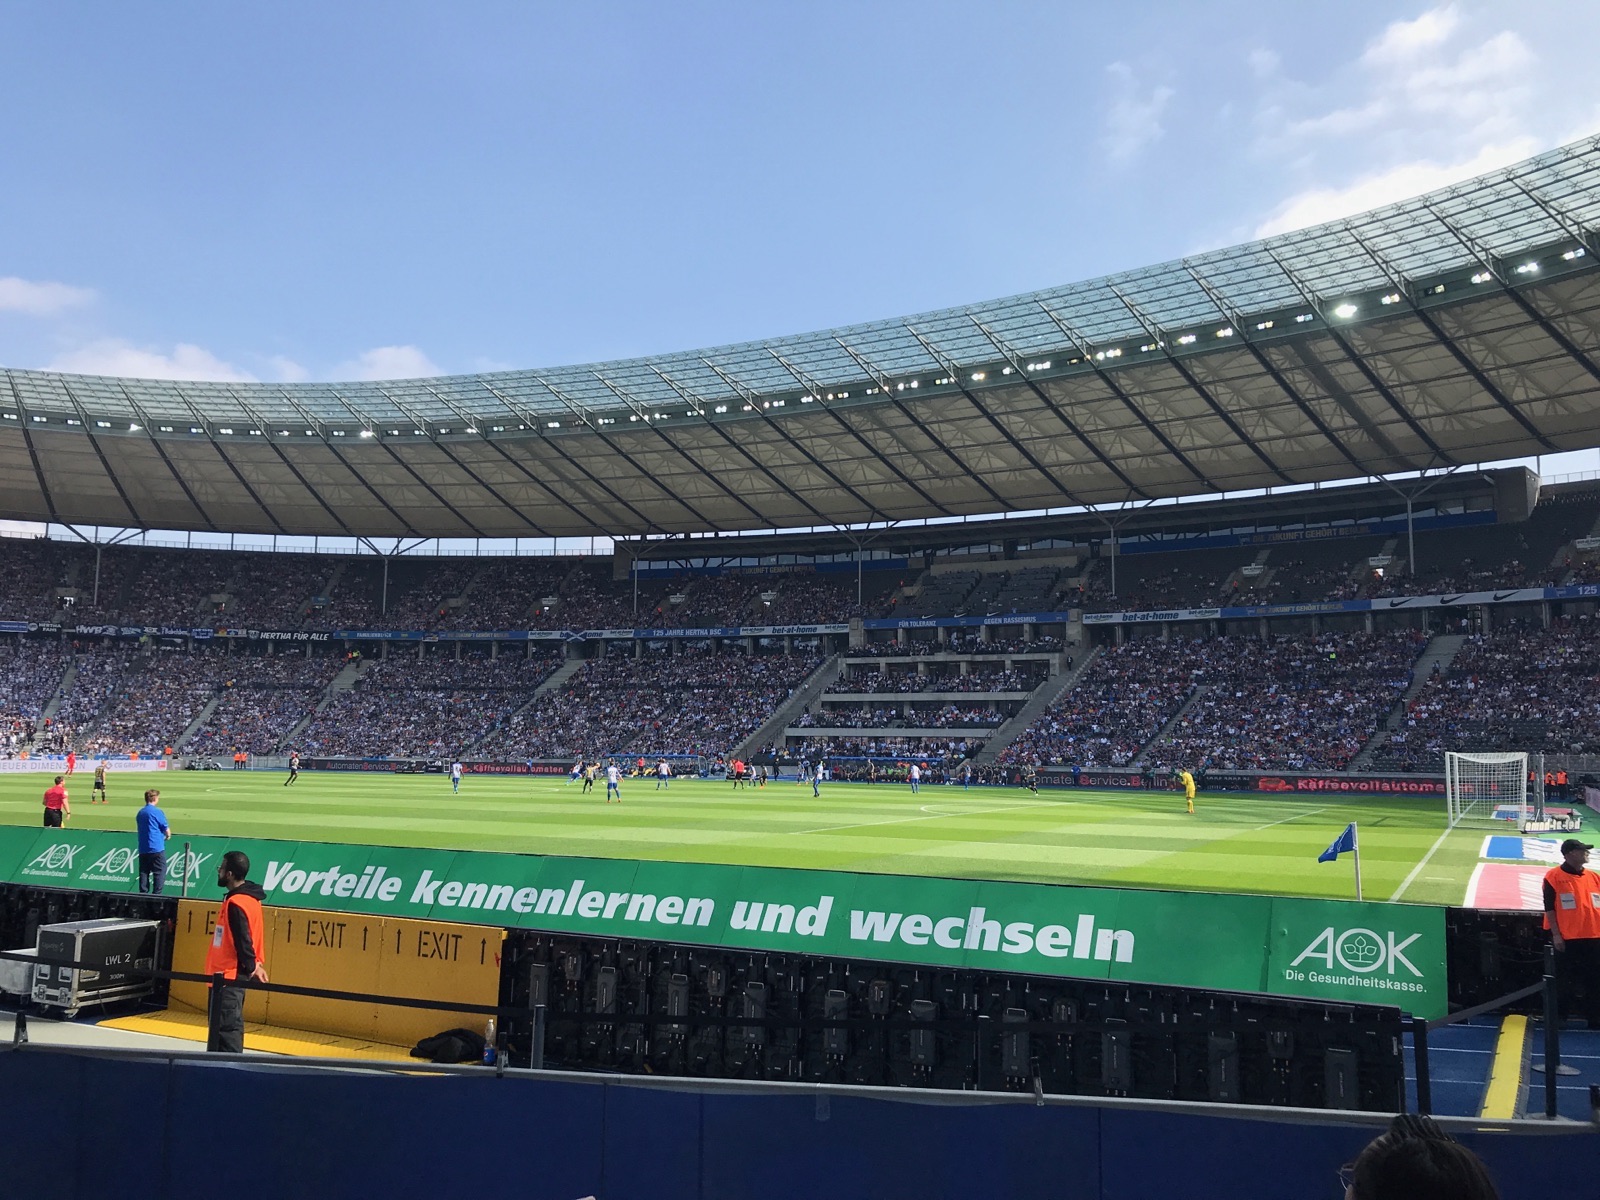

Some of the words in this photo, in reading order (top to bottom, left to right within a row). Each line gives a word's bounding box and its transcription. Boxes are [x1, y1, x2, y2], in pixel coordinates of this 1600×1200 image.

[1577, 585, 1598, 595] 125
[984, 617, 1002, 625] GEGEN
[1003, 616, 1037, 624] RASSISMUS
[1122, 611, 1179, 621] bet-at-home
[260, 632, 292, 640] HERTHA
[293, 631, 309, 640] FÜR
[310, 633, 329, 641] ALLE
[772, 625, 818, 634] bet-at-home
[0, 762, 27, 770] EUER
[31, 762, 85, 770] DIMENSON
[473, 765, 564, 773] Kaffeevollauomaten
[28, 844, 87, 869] AOK
[86, 847, 140, 874] AOK
[263, 860, 403, 902] Vorteile
[409, 869, 715, 927] kennenlernen
[729, 895, 834, 937] und
[849, 906, 1135, 963] wechseln
[306, 919, 347, 949] EXIT
[417, 930, 463, 962] EXIT
[1290, 926, 1424, 978] AOK
[105, 954, 122, 966] LWL
[124, 953, 131, 963] 2
[1285, 969, 1305, 981] Die
[1308, 972, 1427, 993] Gesundheitskasse.
